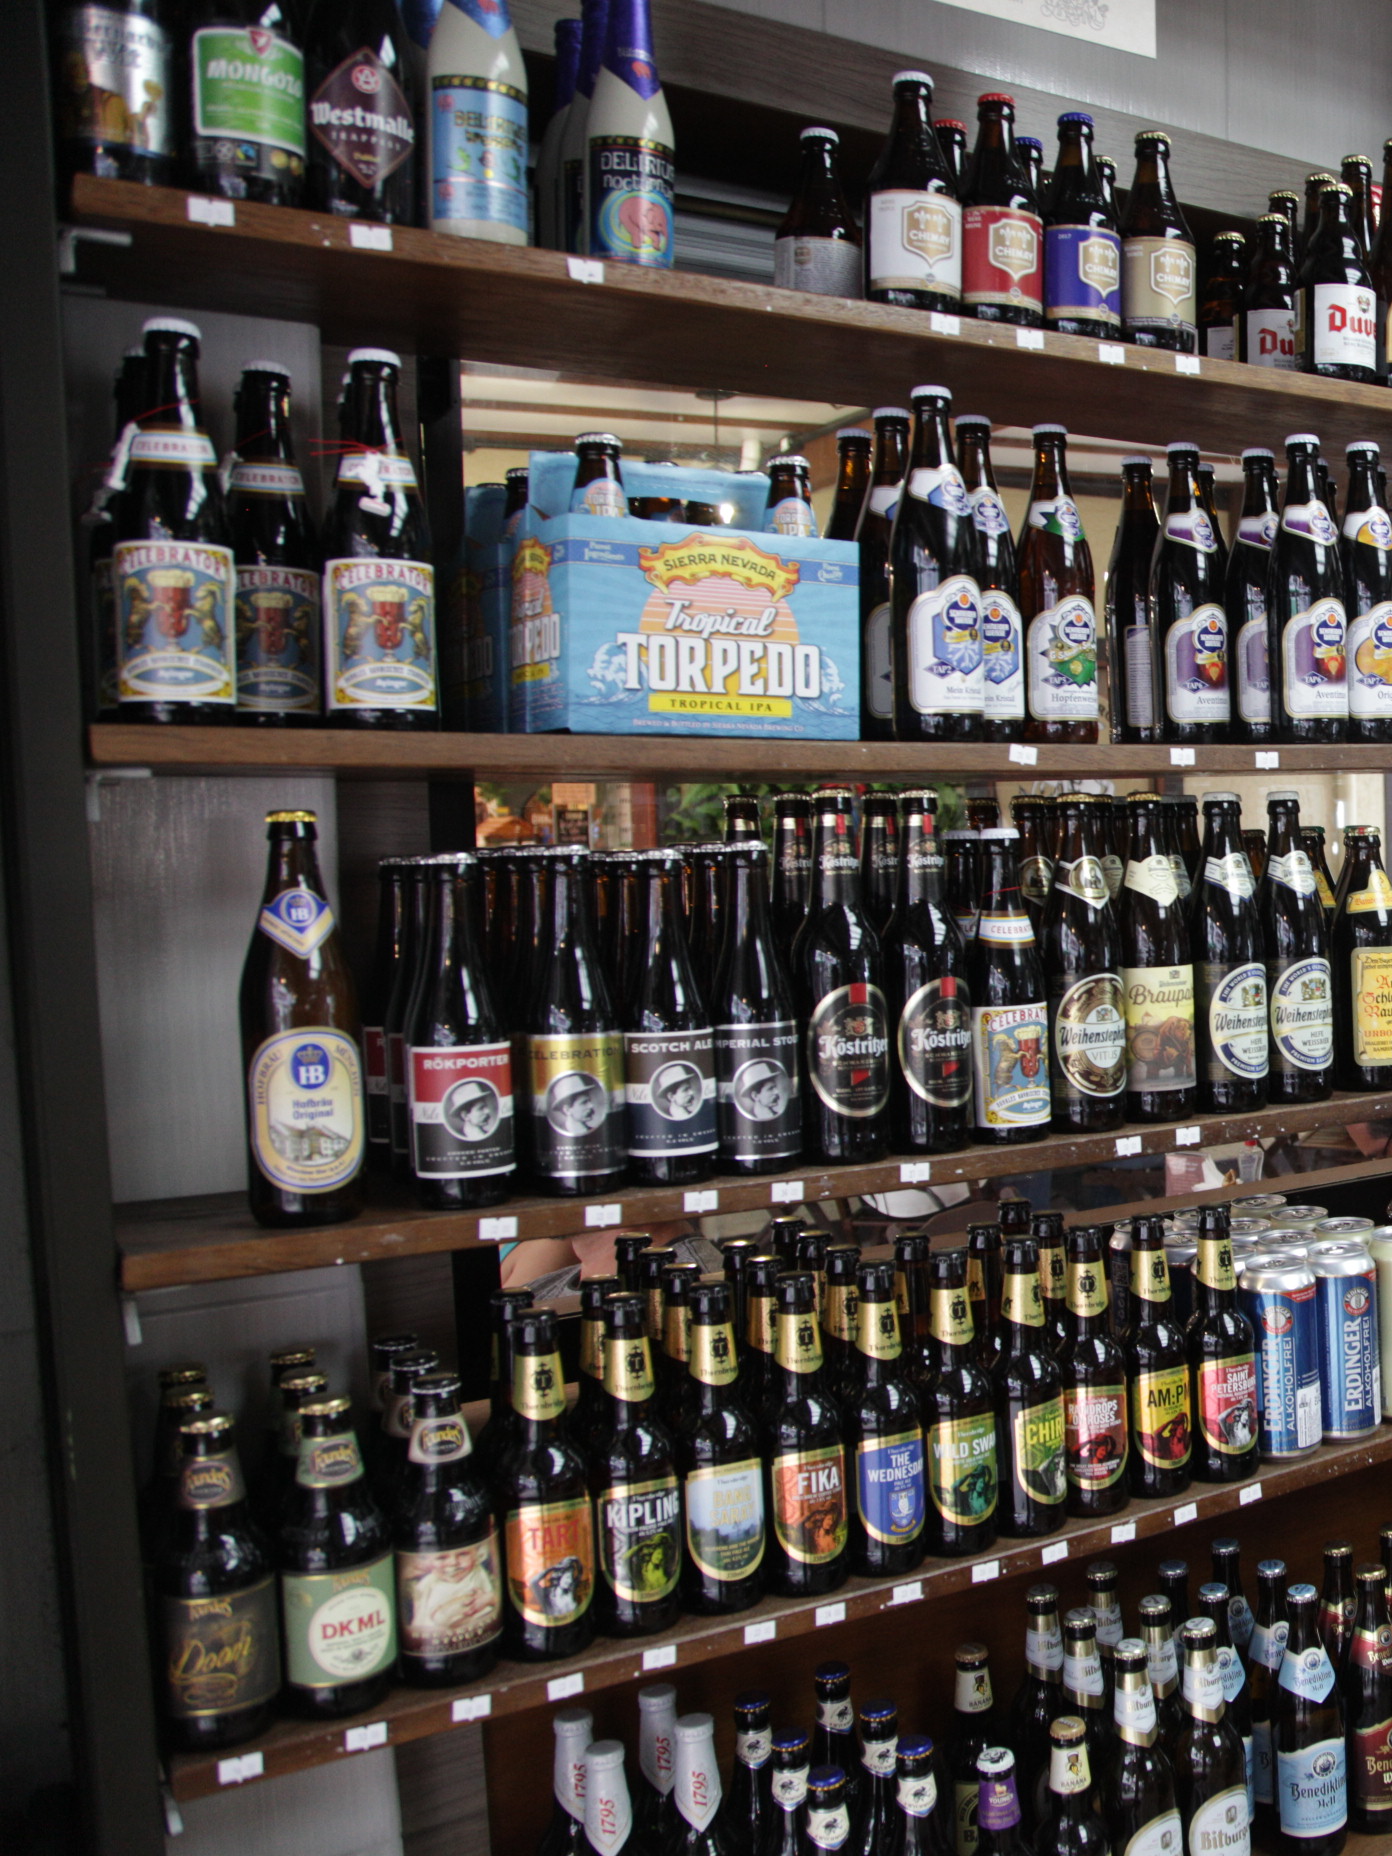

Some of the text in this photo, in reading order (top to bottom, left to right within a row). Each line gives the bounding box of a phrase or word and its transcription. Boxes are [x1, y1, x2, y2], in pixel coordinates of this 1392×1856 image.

[311, 103, 414, 143] Westmalle
[663, 553, 776, 581] SIERRA NEVADA
[664, 600, 777, 638] Tropical
[617, 633, 821, 698] TORPEDO
[670, 699, 772, 712] TROPICAL IPA
[290, 908, 308, 921] HB
[631, 1039, 713, 1053] SCOTCH ALE
[1311, 1030, 1324, 1038] HEFE
[819, 1035, 888, 1058] Köstritzer
[1093, 1050, 1118, 1061] VITUS
[423, 1054, 509, 1069] RÖKPORTER
[299, 1066, 325, 1086] HB
[293, 1099, 332, 1109] Hofbräu
[293, 1109, 333, 1121] Original
[1345, 1317, 1362, 1412] ERDINGER
[1364, 1317, 1373, 1407] ALKOHOLFREI
[1227, 1369, 1249, 1384] SAINT
[1263, 1330, 1282, 1433] ERDINGER
[1286, 1337, 1297, 1431] ALKOHOLFREI
[1068, 1400, 1117, 1414] RAINDROPS
[1088, 1412, 1115, 1423] ROSES
[890, 1452, 910, 1466] THE
[933, 1441, 967, 1460] WILD
[797, 1469, 839, 1495] FIKA
[606, 1490, 679, 1528] KIPLING
[713, 1486, 752, 1508] BANG
[529, 1519, 579, 1549] TART
[321, 1610, 385, 1641] DKML
[656, 1736, 671, 1771] 1795
[572, 1763, 587, 1799] 1795
[692, 1771, 708, 1808] 1795
[600, 1798, 616, 1836] 1795
